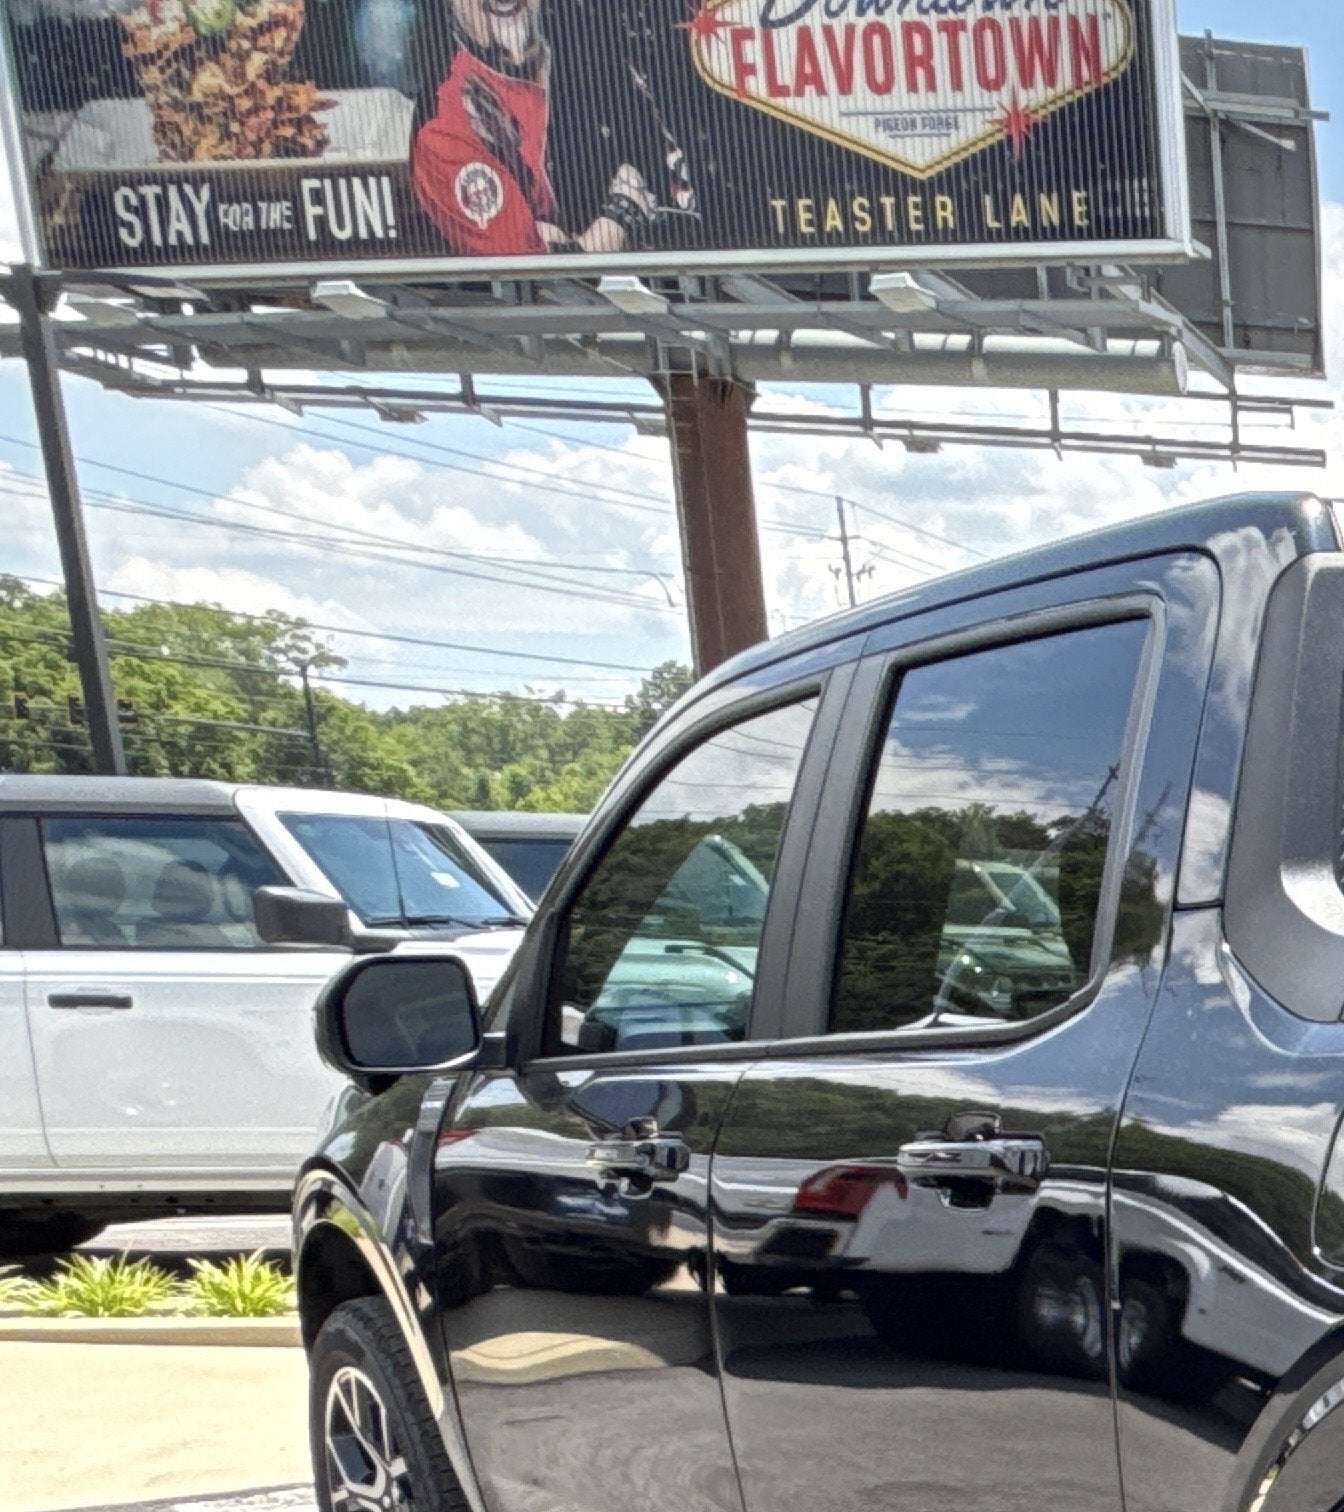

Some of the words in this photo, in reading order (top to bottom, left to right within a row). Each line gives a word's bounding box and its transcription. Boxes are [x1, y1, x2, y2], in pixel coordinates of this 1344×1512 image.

[730, 14, 1102, 98] FLAVORTOWN
[114, 183, 210, 247] STAY
[218, 203, 254, 231] FOR
[257, 201, 292, 230] THE
[301, 176, 397, 241] FUN!
[771, 195, 955, 234] TEASTER
[984, 190, 1090, 229] LANE
